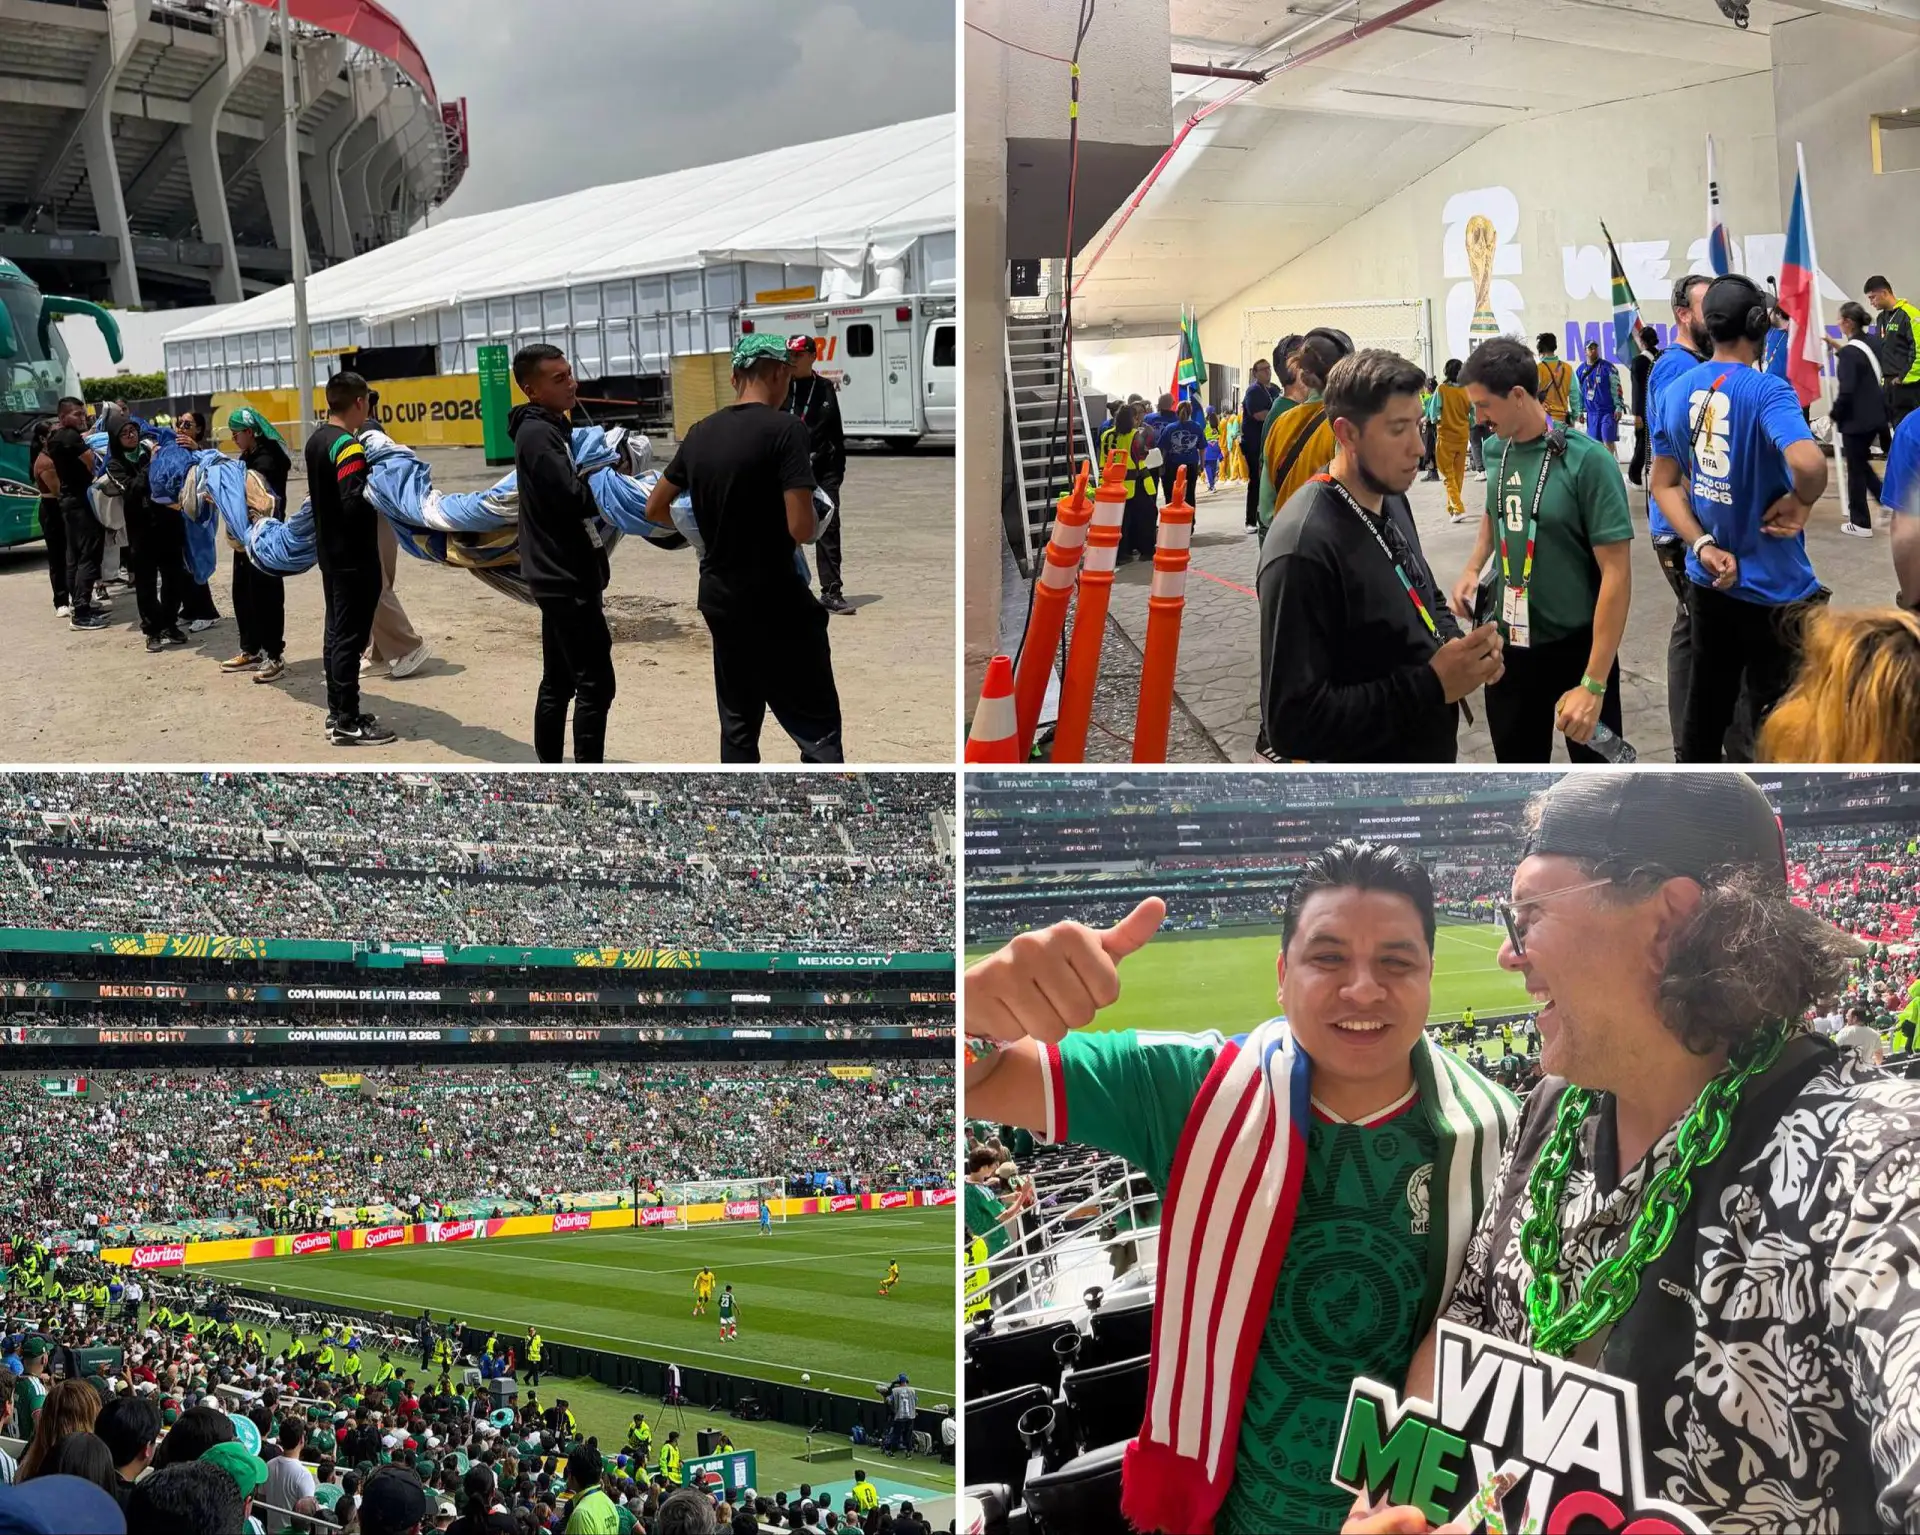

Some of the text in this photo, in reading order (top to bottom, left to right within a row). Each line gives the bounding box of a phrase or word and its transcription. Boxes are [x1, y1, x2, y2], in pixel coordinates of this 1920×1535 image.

[396, 403, 426, 422] CUP
[1702, 457, 1718, 470] FIFA
[1714, 481, 1731, 491] CUP
[1694, 483, 1733, 505] 2026
[1334, 484, 1393, 561] FIFA WORLD CUP 2026
[998, 780, 1018, 788] FIFA
[798, 956, 892, 966] MEXICO CITY
[99, 985, 187, 998] MEXICO CITY
[288, 989, 441, 1000] COPA MUNDIAL DE LA FIFA 2026
[529, 991, 600, 1002] MEXICO CITY
[99, 1031, 187, 1043] MEXICO CITY
[288, 1030, 441, 1041] COPA MUNDIAL DE LA FIFA 2026
[529, 1030, 600, 1040] MEXICO CITY
[553, 1213, 590, 1231] Sabritas
[641, 1208, 677, 1225] Sabritas
[366, 1226, 404, 1248] Sabritas
[440, 1221, 475, 1241] Sabritas
[293, 1235, 331, 1254] Sabritas
[133, 1246, 184, 1267] Sabritas
[1441, 1338, 1624, 1497] VIVA
